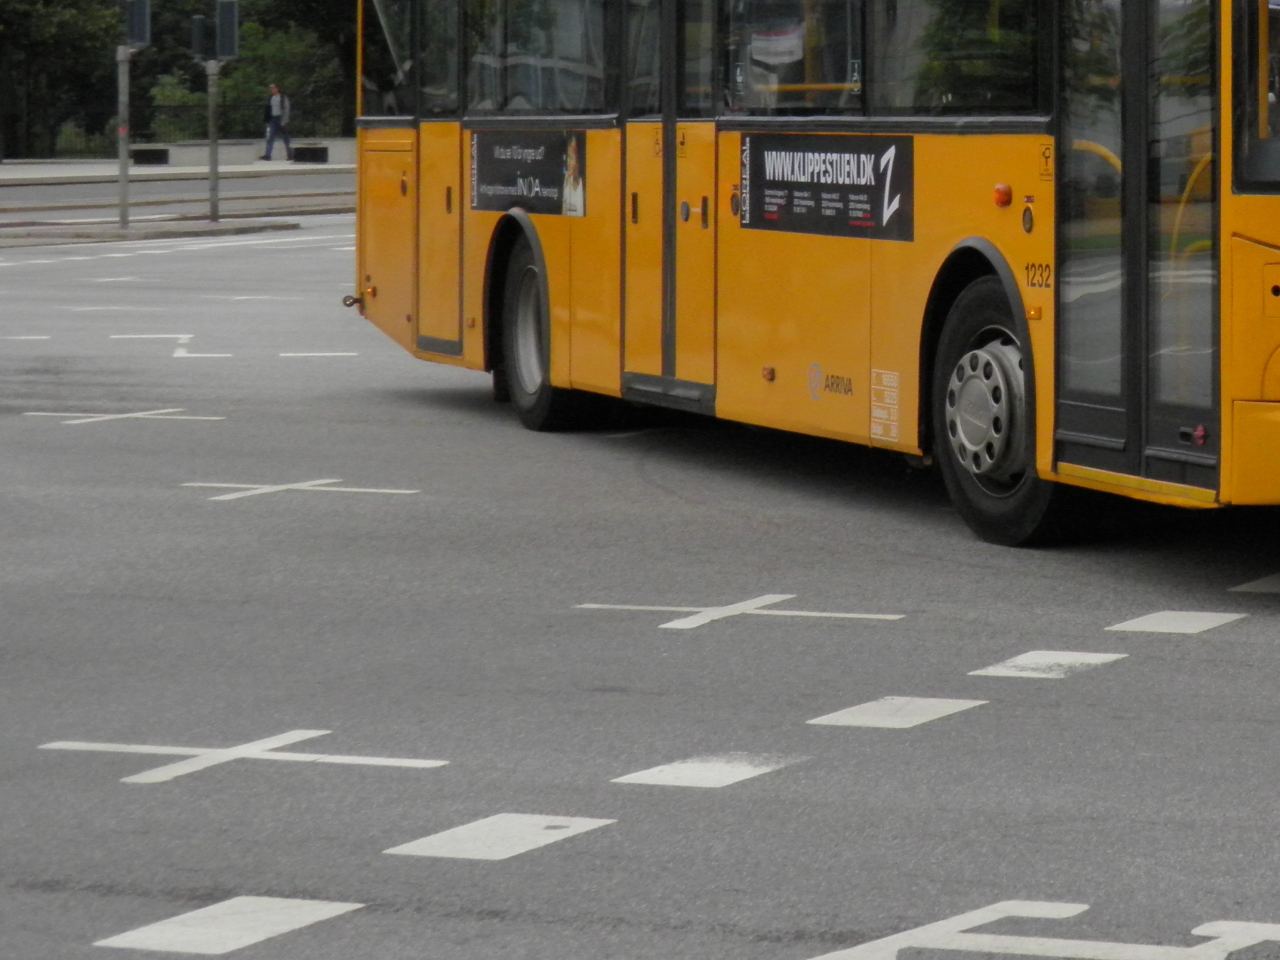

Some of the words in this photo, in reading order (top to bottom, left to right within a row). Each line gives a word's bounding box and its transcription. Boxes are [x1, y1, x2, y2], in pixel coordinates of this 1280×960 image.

[764, 150, 876, 186] WWW.KLIPPESTUEN.DK
[1024, 262, 1052, 289] 1232
[823, 374, 854, 397] ARRIVA
